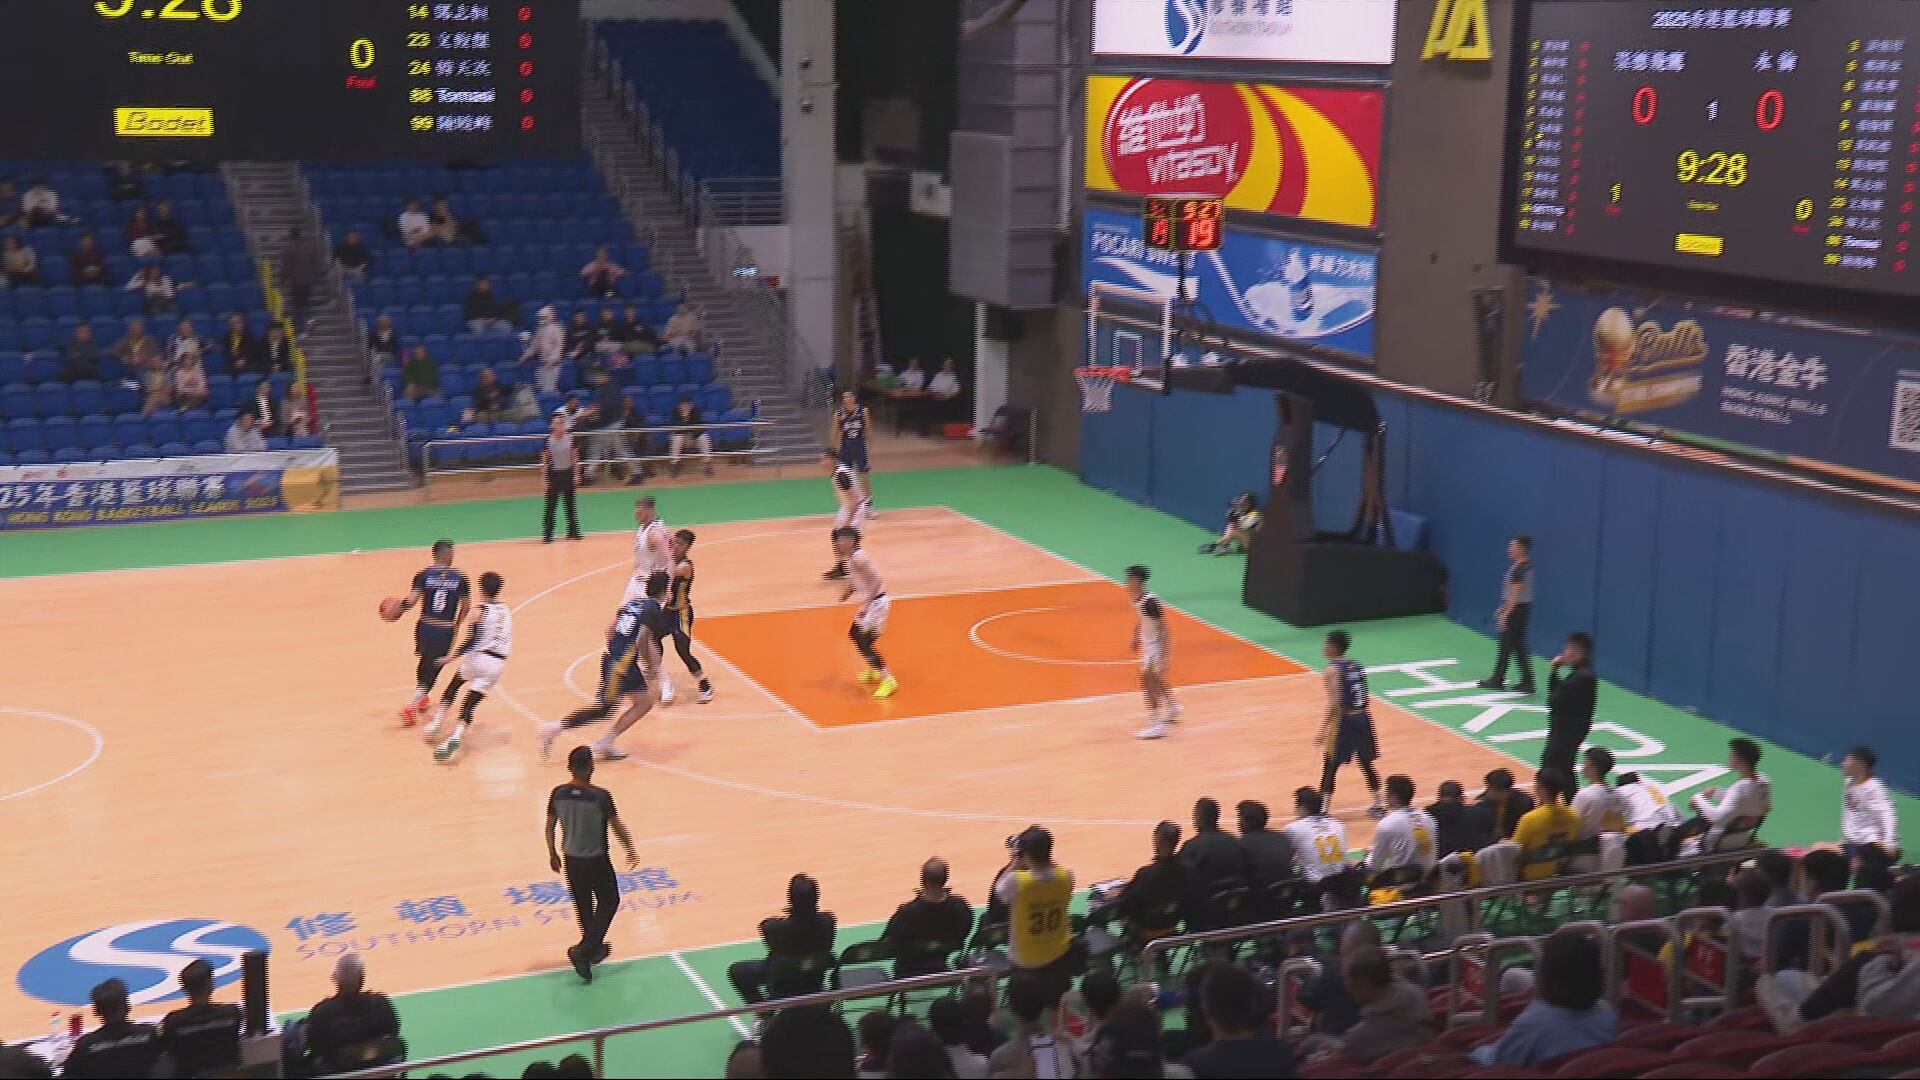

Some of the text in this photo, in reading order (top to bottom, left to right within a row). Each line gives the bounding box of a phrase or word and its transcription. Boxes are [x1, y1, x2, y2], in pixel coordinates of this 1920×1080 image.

[407, 32, 431, 47] 23
[350, 39, 376, 69] 0
[408, 60, 432, 75] 24
[409, 88, 433, 102] 88
[434, 87, 497, 103] Tomasi
[1631, 85, 1658, 125] 0
[124, 111, 209, 132] Bodet
[410, 115, 434, 130] 99
[1705, 99, 1718, 121] 1
[1755, 89, 1785, 131] 0
[1676, 150, 1748, 186] 9:28
[1609, 183, 1621, 202] 1
[1795, 199, 1813, 220] 0
[1091, 231, 1146, 260] POCARI
[1188, 218, 1216, 247] 19
[1723, 343, 1829, 390] 香港金牛
[432, 588, 449, 612] 6
[1351, 682, 1366, 708] 3
[1314, 835, 1345, 865] 12
[1029, 908, 1063, 936] 30
[296, 916, 522, 961] SOUTHORN
